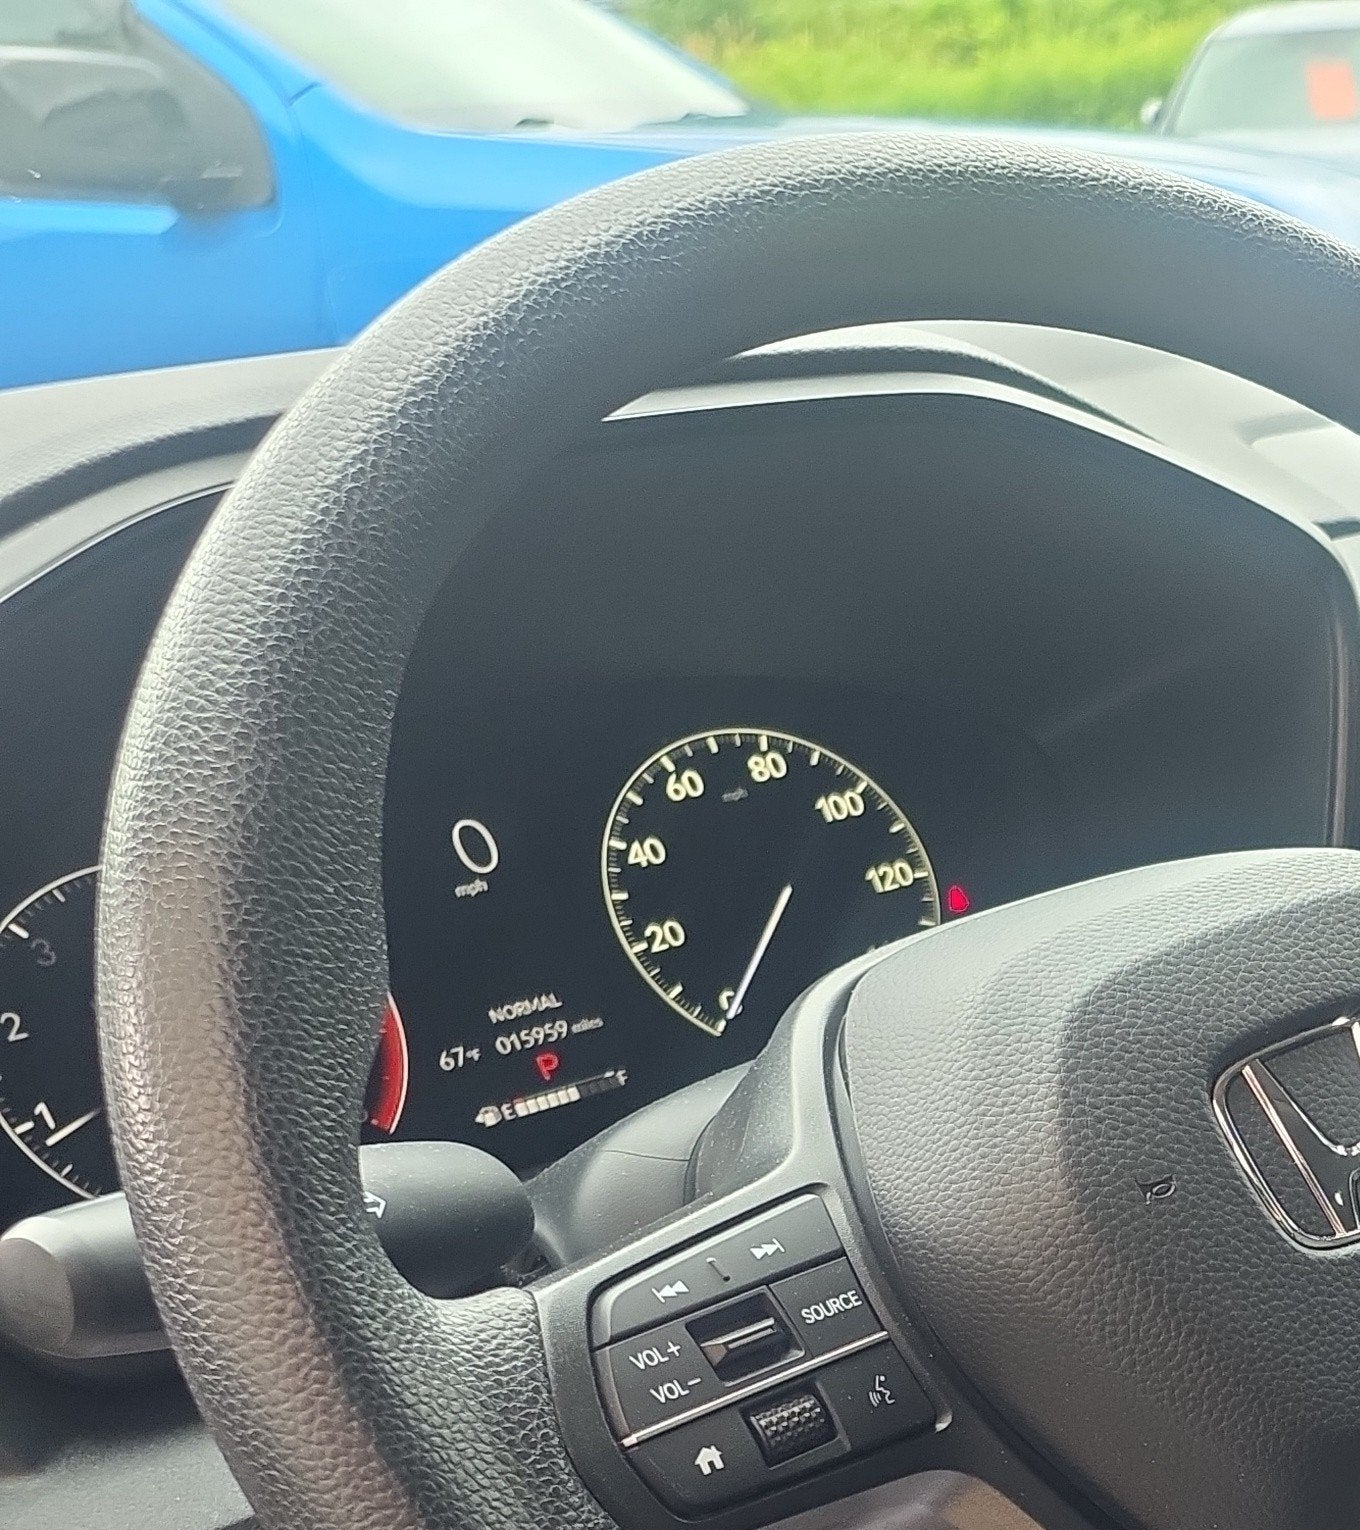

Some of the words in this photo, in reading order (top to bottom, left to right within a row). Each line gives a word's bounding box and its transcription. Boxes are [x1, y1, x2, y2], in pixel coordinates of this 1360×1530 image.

[747, 751, 788, 782] 80
[665, 768, 704, 802] 60
[814, 791, 865, 823] 100
[452, 819, 498, 873] 0
[627, 836, 666, 867] 40
[865, 859, 914, 894] 120
[31, 938, 56, 966] 3
[645, 919, 686, 953] 20
[488, 992, 563, 1024] NORMAL
[0, 1012, 29, 1042] 2
[495, 1020, 568, 1055] 015959
[535, 1053, 559, 1081] P
[33, 1101, 55, 1130] 1
[801, 1290, 862, 1325] SOURCE
[629, 1341, 681, 1371] VOL+
